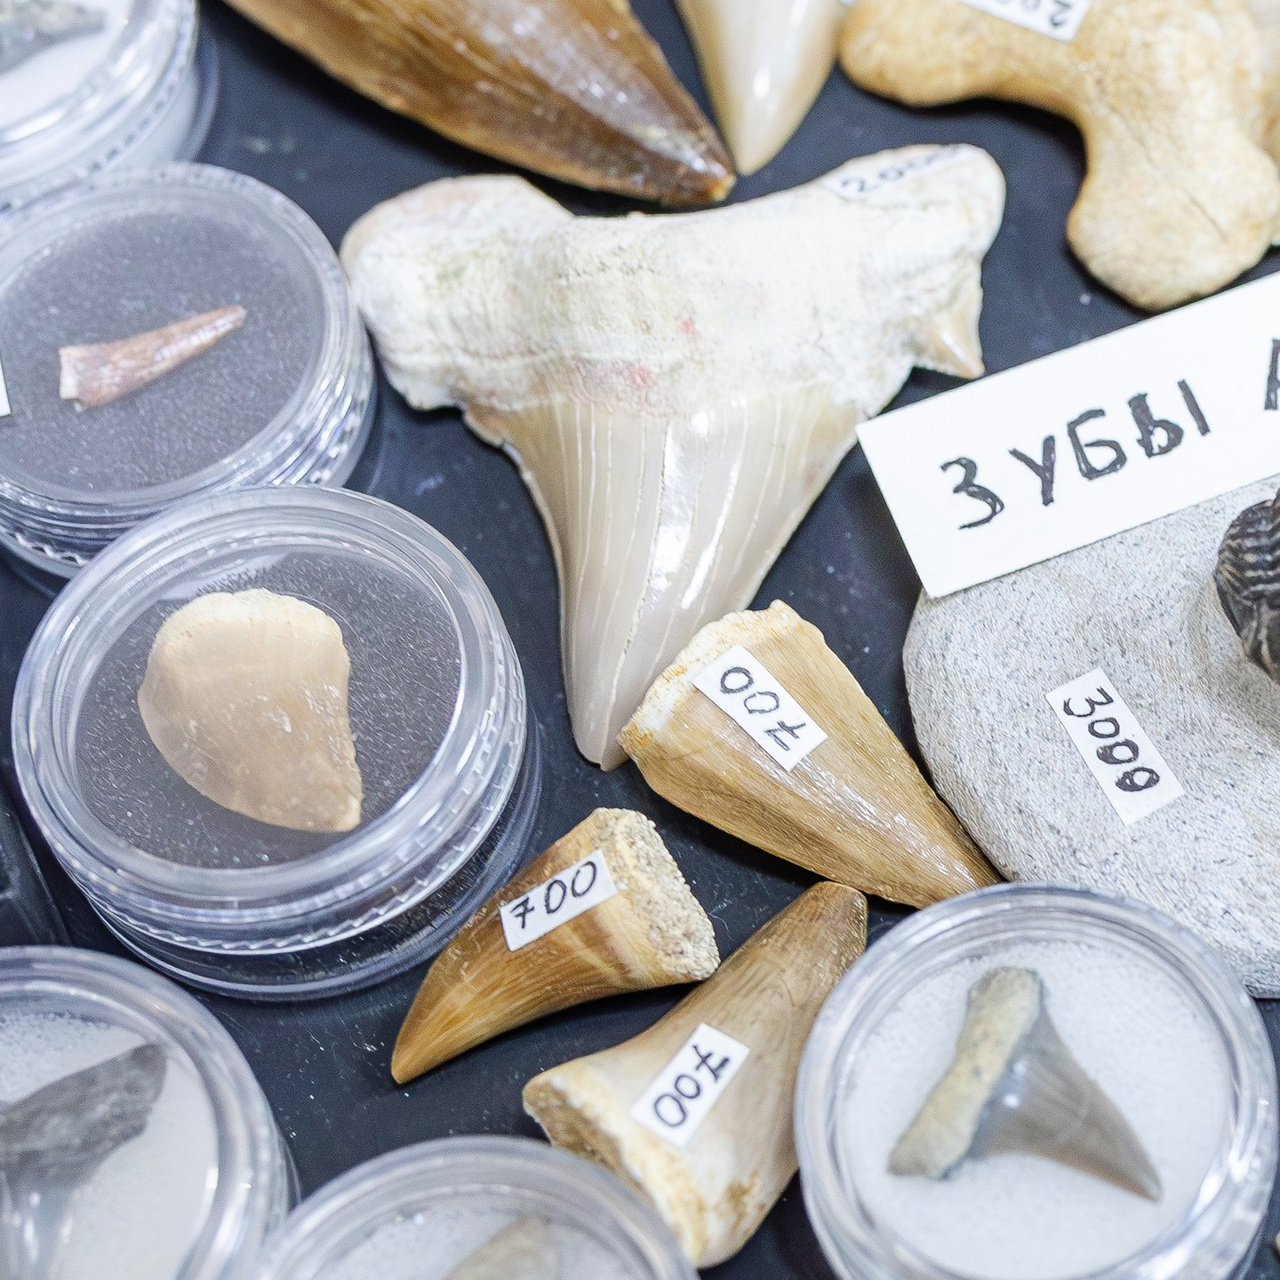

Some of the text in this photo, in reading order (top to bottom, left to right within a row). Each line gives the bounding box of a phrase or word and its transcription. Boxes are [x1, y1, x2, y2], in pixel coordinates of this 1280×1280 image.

[939, 377, 1213, 531] ЗУБЫ
[720, 666, 807, 752] 700
[1063, 685, 1161, 793] 3000
[510, 861, 597, 929] 700
[654, 1045, 730, 1127] 700
